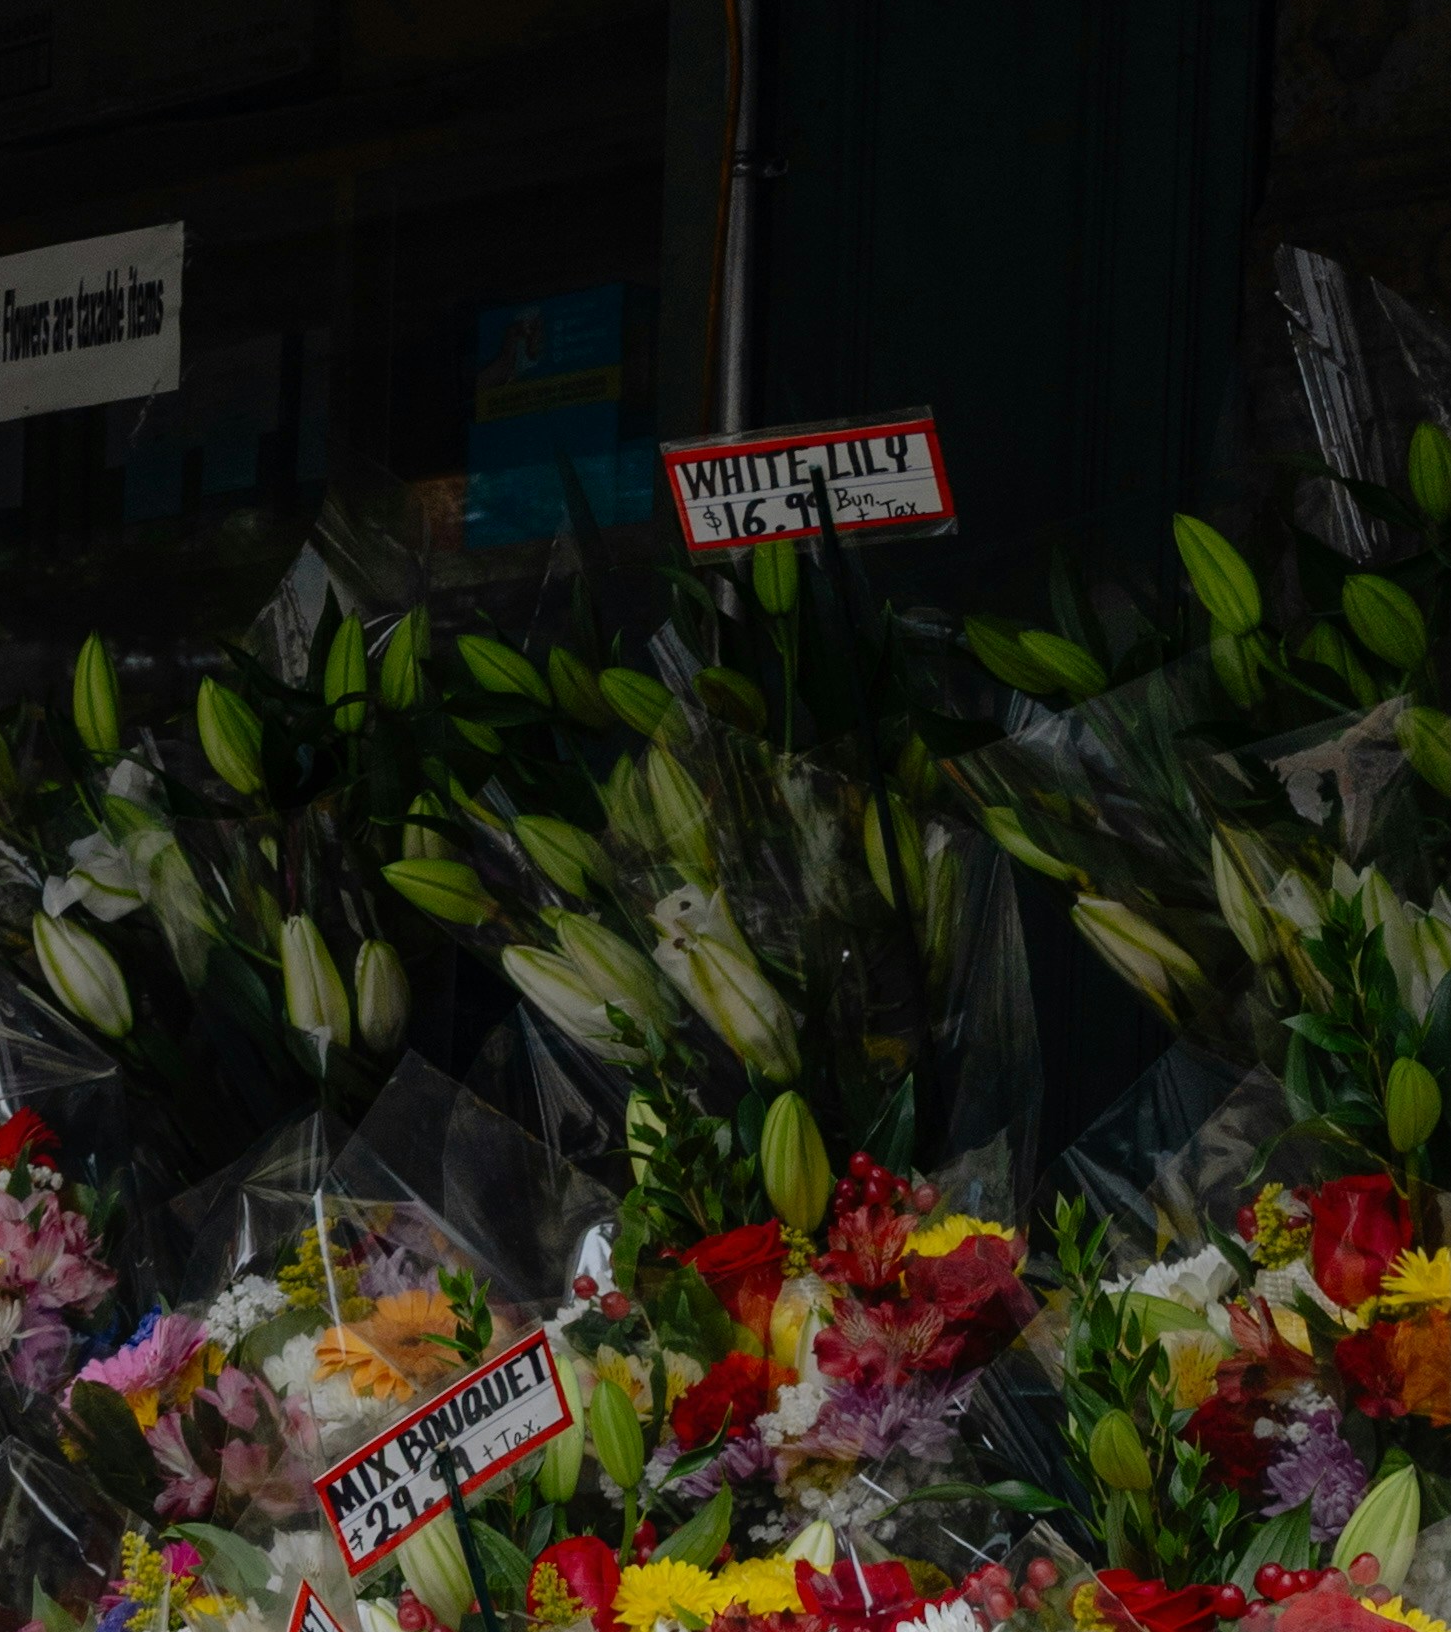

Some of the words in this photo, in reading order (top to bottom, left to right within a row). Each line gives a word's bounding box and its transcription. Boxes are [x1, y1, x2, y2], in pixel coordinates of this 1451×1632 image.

[2, 288, 50, 363] Flowers
[53, 296, 74, 353] are
[78, 268, 124, 350] taxable
[127, 266, 164, 341] items
[679, 444, 810, 501] WHITE
[826, 435, 912, 480] LILY
[326, 1447, 401, 1523] MIX
[396, 1342, 546, 1475] BOUQUET
